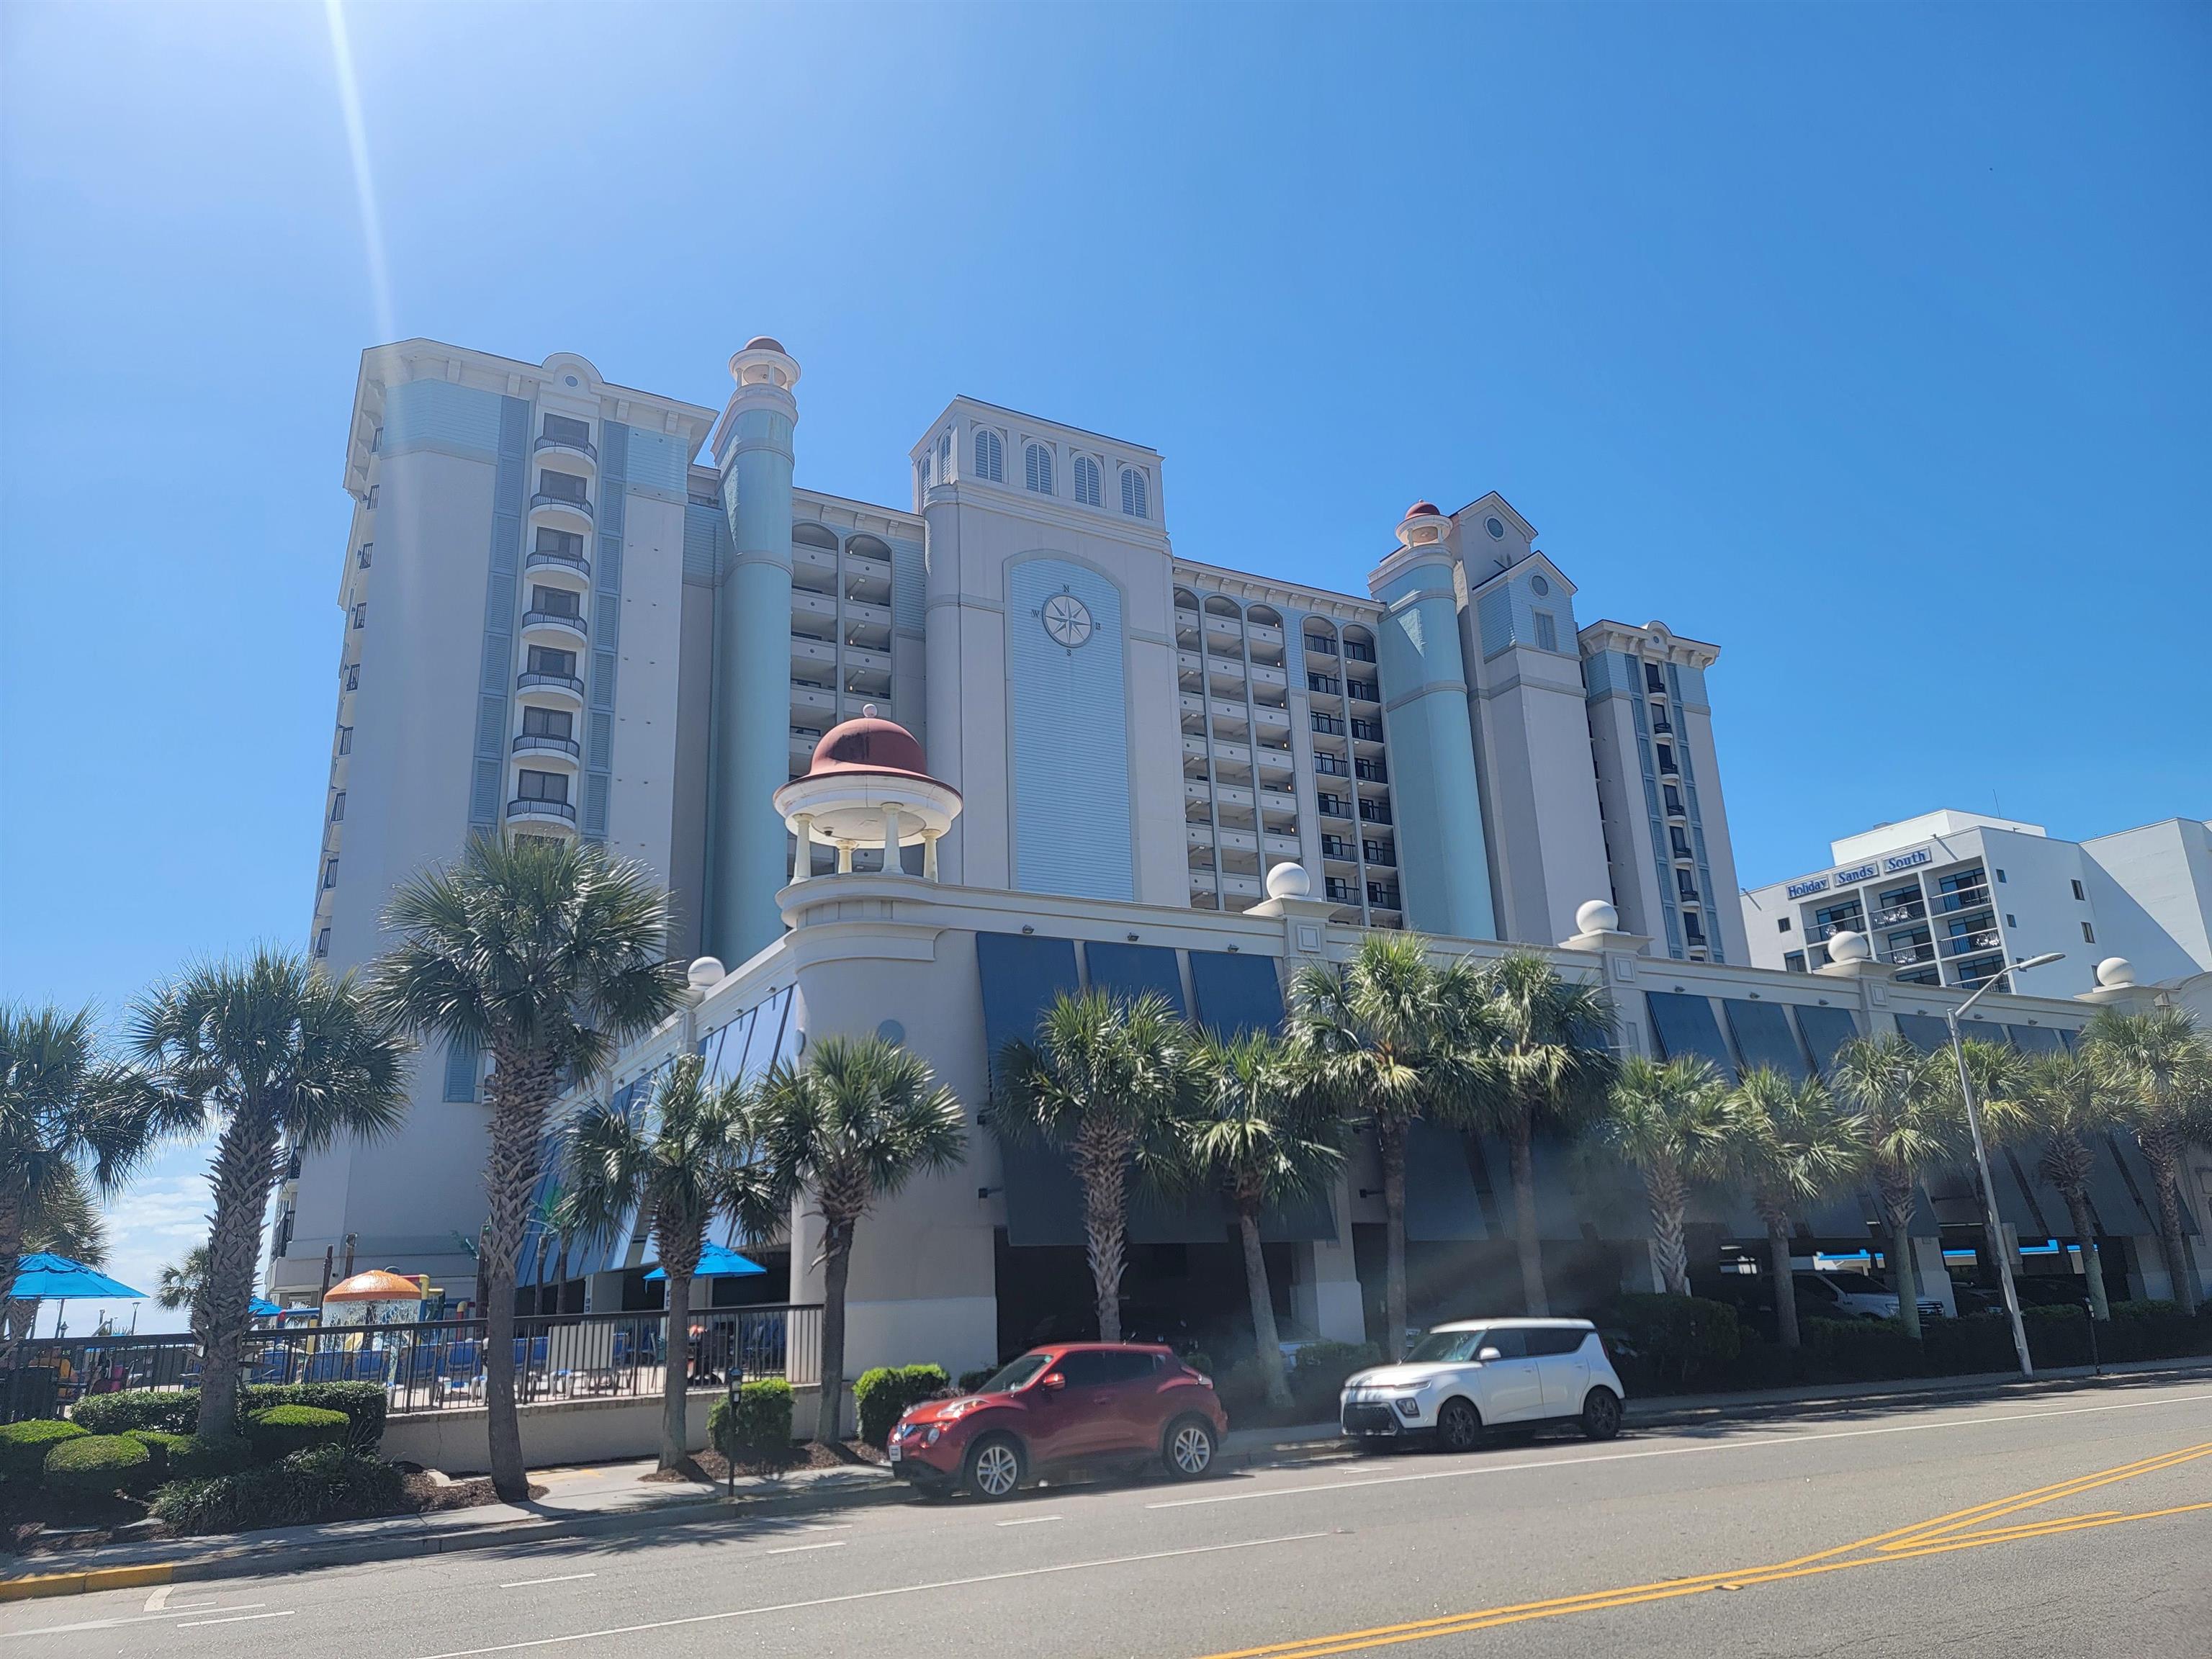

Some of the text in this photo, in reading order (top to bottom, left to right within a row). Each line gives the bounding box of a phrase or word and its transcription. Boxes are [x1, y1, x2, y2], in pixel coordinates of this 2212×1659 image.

[1788, 851, 1925, 897] Holiday Sands South
